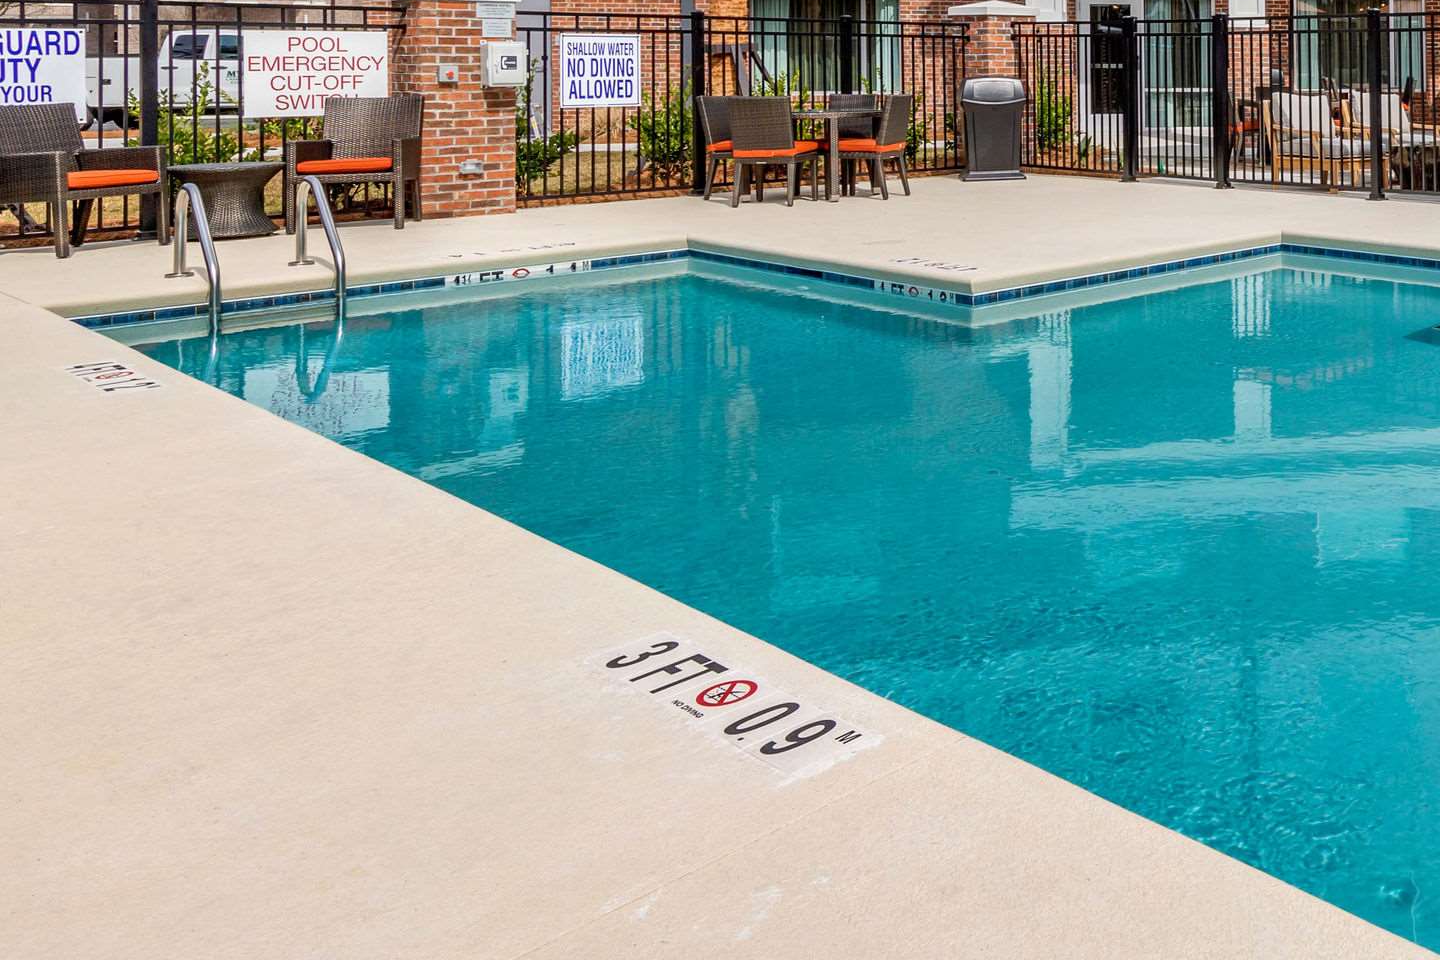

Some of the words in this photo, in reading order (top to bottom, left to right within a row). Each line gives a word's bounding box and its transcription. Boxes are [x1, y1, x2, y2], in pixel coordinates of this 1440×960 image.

[0, 30, 80, 56] UARD
[287, 37, 348, 52] POOL
[567, 42, 606, 56] SHALLOW
[607, 42, 634, 56] WATER
[248, 56, 384, 72] EMERGENCY
[567, 58, 586, 77] NO
[591, 58, 634, 77] DIVING
[270, 75, 364, 90] CUT-OFF
[569, 79, 633, 99] ALLOWED
[1, 85, 52, 103] YOUR
[275, 94, 358, 111] SWIT
[606, 641, 679, 668] 3
[629, 653, 729, 694] FT
[672, 699, 684, 707] NO
[680, 704, 704, 719] DIVING
[724, 702, 837, 755] 0.9
